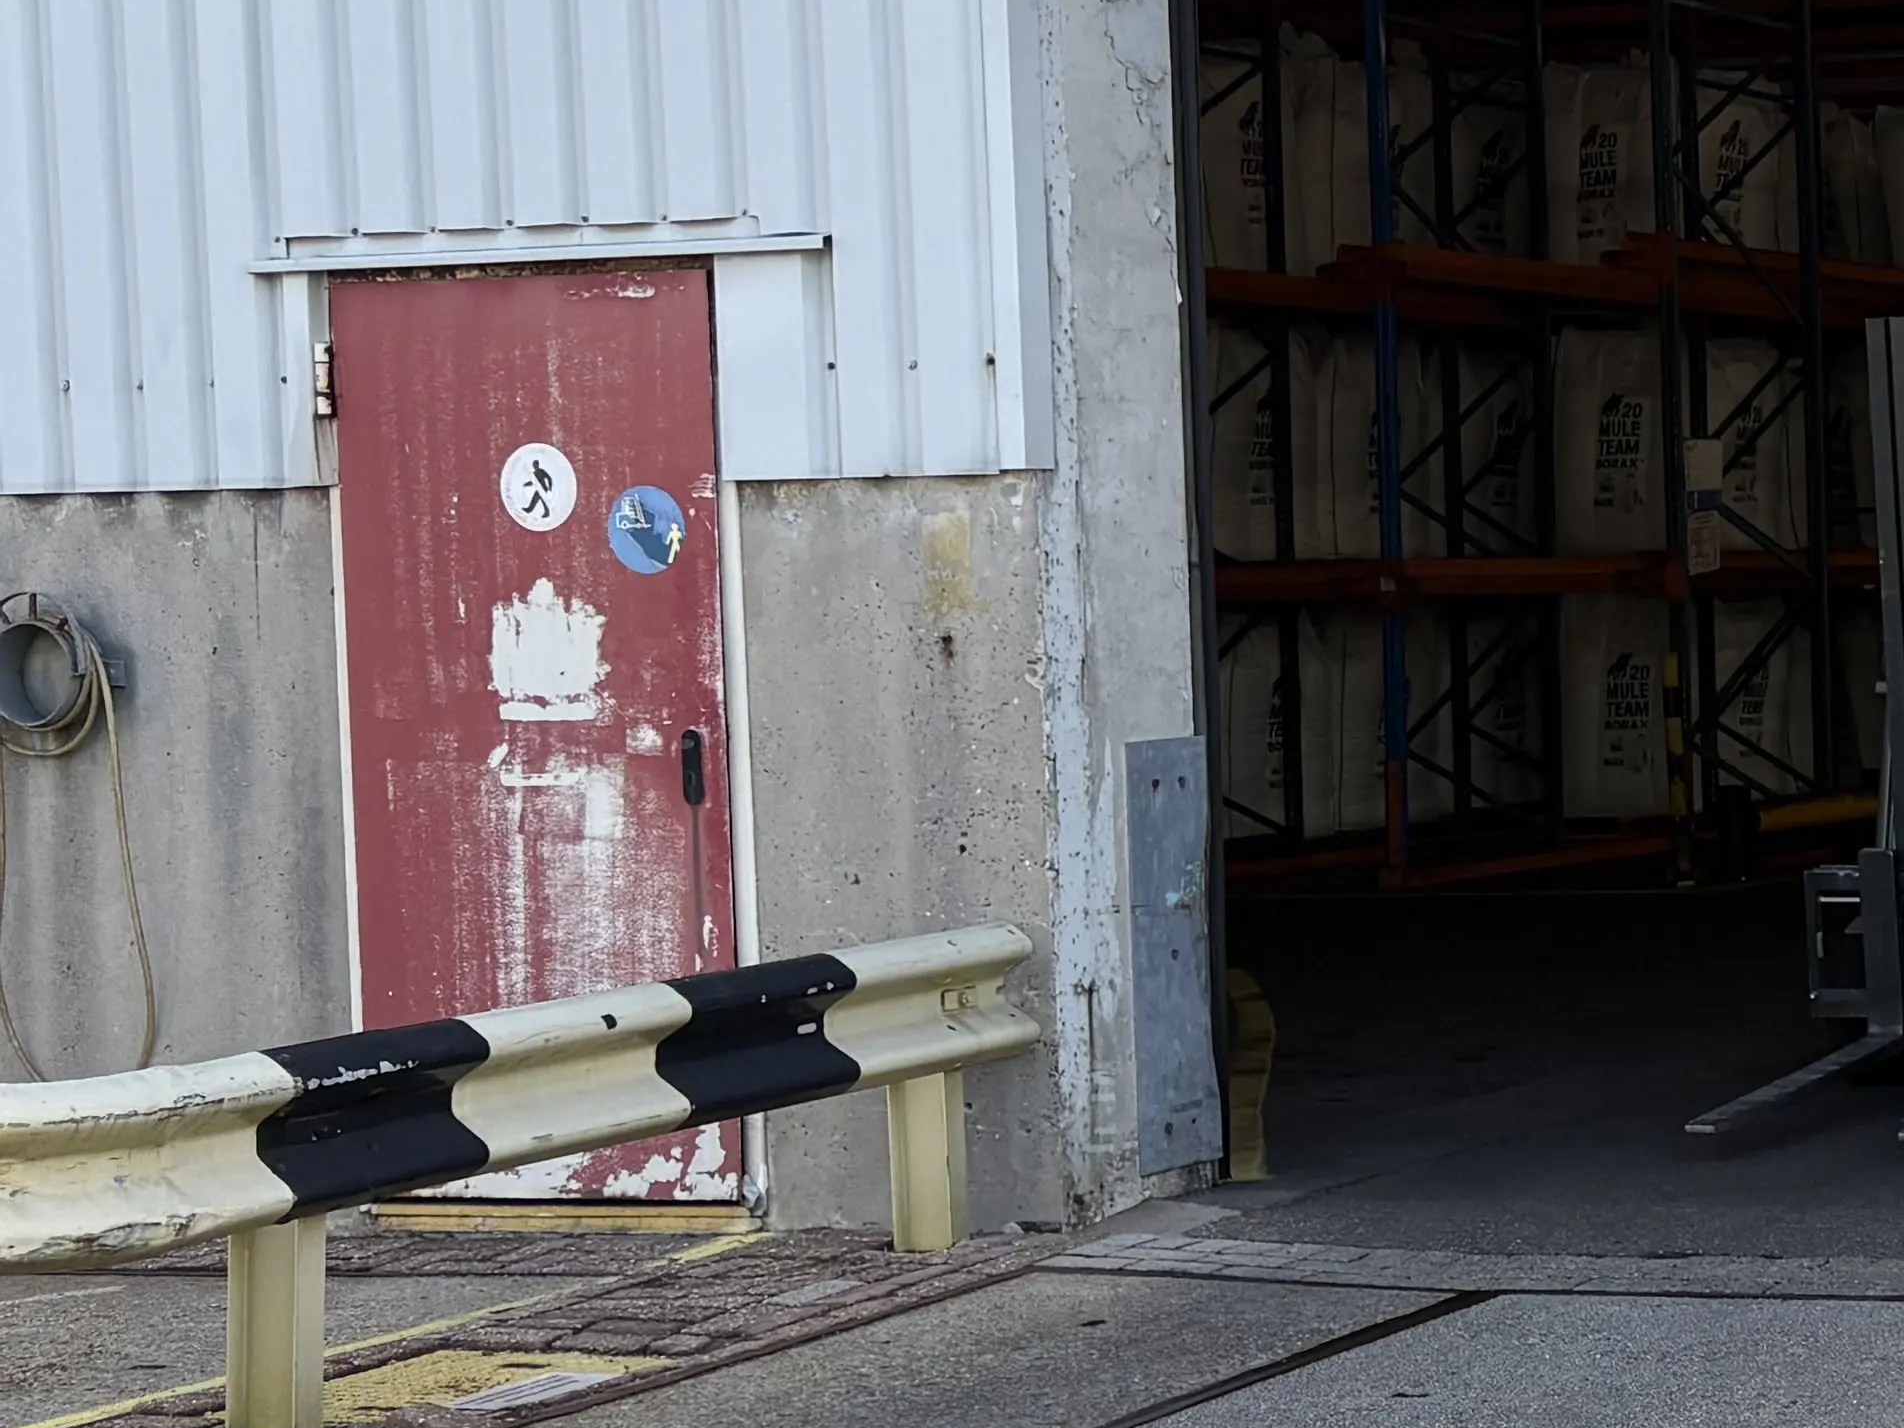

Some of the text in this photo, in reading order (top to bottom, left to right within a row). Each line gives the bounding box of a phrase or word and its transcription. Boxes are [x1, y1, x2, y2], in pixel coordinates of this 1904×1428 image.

[1599, 132, 1617, 149] 20
[1580, 150, 1617, 169] MULE
[1580, 169, 1617, 187] TEAM
[1622, 402, 1643, 419] 20
[1599, 419, 1642, 438] MULE
[1598, 438, 1640, 457] TEAM
[1630, 665, 1650, 681] 20
[1607, 681, 1649, 700] MULE
[1607, 700, 1649, 718] TEAM
